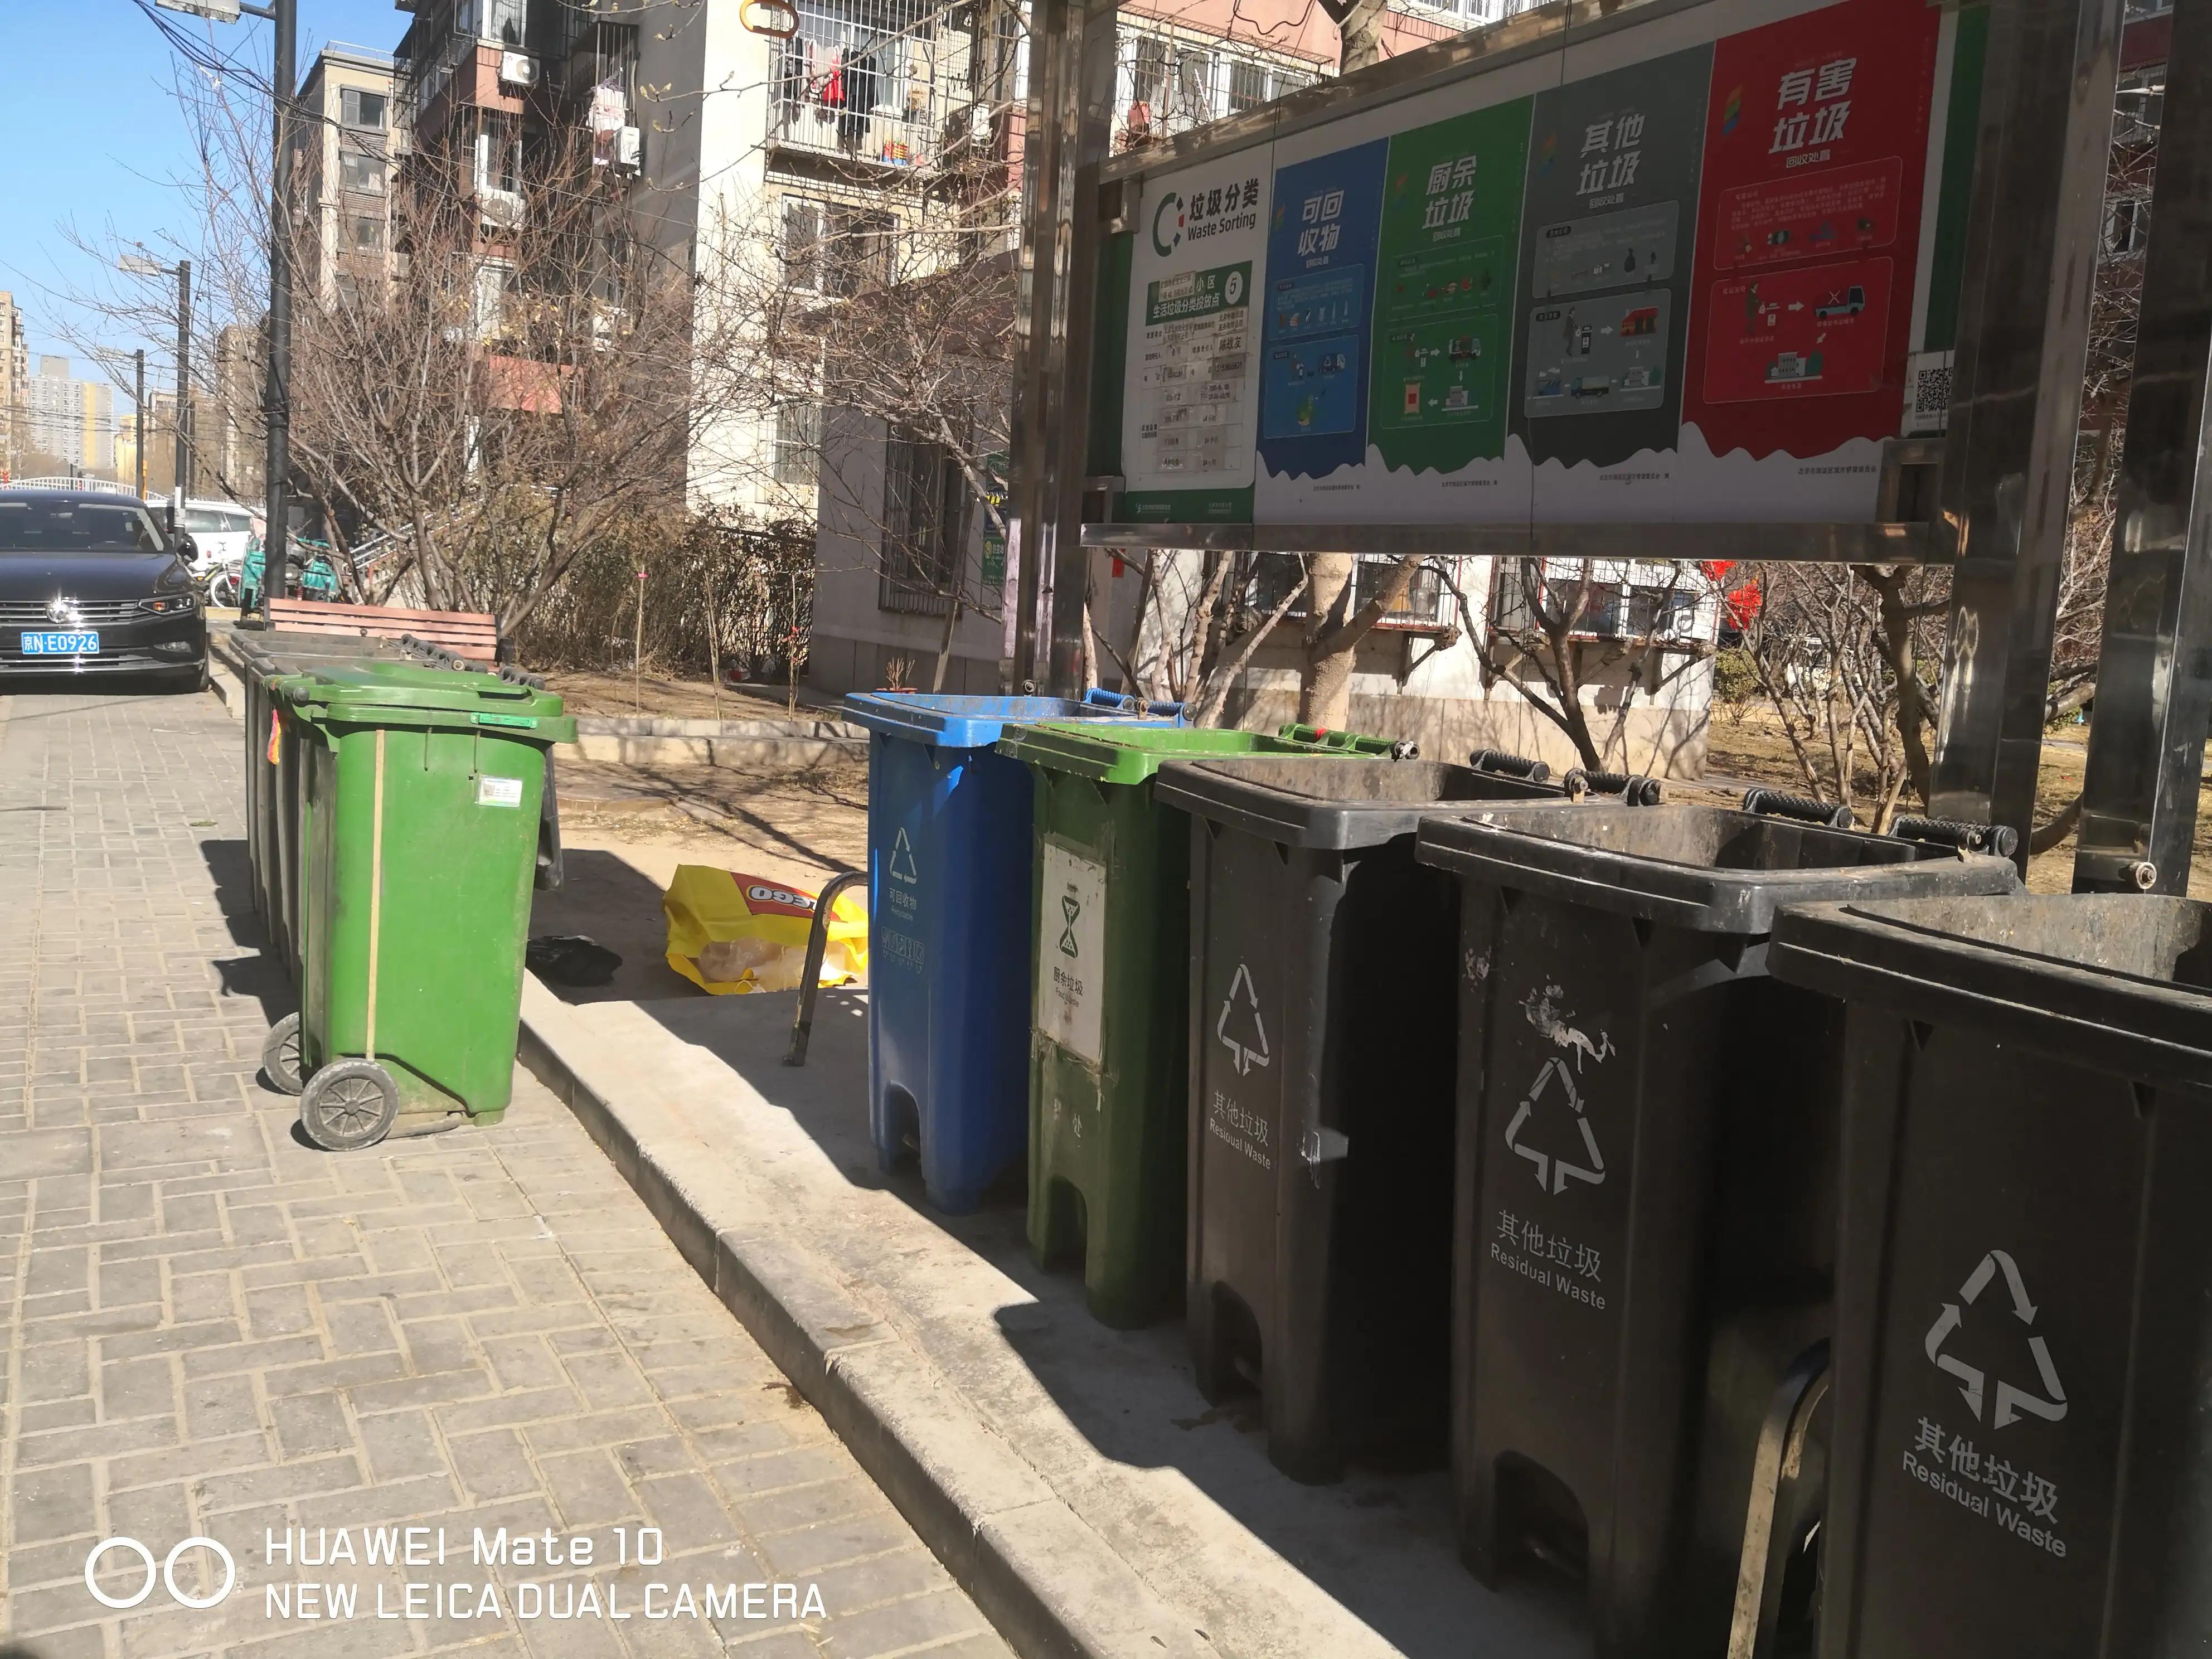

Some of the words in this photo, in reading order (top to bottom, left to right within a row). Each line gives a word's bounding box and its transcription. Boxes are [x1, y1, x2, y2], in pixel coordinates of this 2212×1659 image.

[1777, 58, 1857, 110] 有害
[1579, 113, 1646, 158] 其他
[1768, 100, 1852, 154] 垃圾
[1425, 155, 1477, 196] 厨余
[1575, 149, 1642, 196] 垃圾
[1189, 178, 1259, 221] 垃圾分类
[1302, 190, 1345, 224] 可回
[1422, 190, 1475, 230] 垃圾
[1187, 222, 1216, 241] Waste
[1219, 212, 1257, 234] Sorting
[1297, 224, 1341, 257] 收物
[1152, 292, 1220, 319] 生活垃圾分类投放点
[1229, 278, 1237, 294] 5
[889, 887, 917, 910] 可回收物
[1053, 966, 1084, 997] 厨余垃圾
[1213, 1089, 1268, 1147] 其他垃圾
[1210, 1117, 1243, 1151] Residual
[1244, 1140, 1271, 1170] Waste
[1497, 1209, 1601, 1283] 其他垃圾
[1491, 1242, 1551, 1287] Residual
[1555, 1273, 1606, 1310] Waste
[1914, 1416, 2058, 1525] 其他垃圾
[1903, 1450, 1990, 1518] Residual
[1996, 1502, 2067, 1558] Waste
